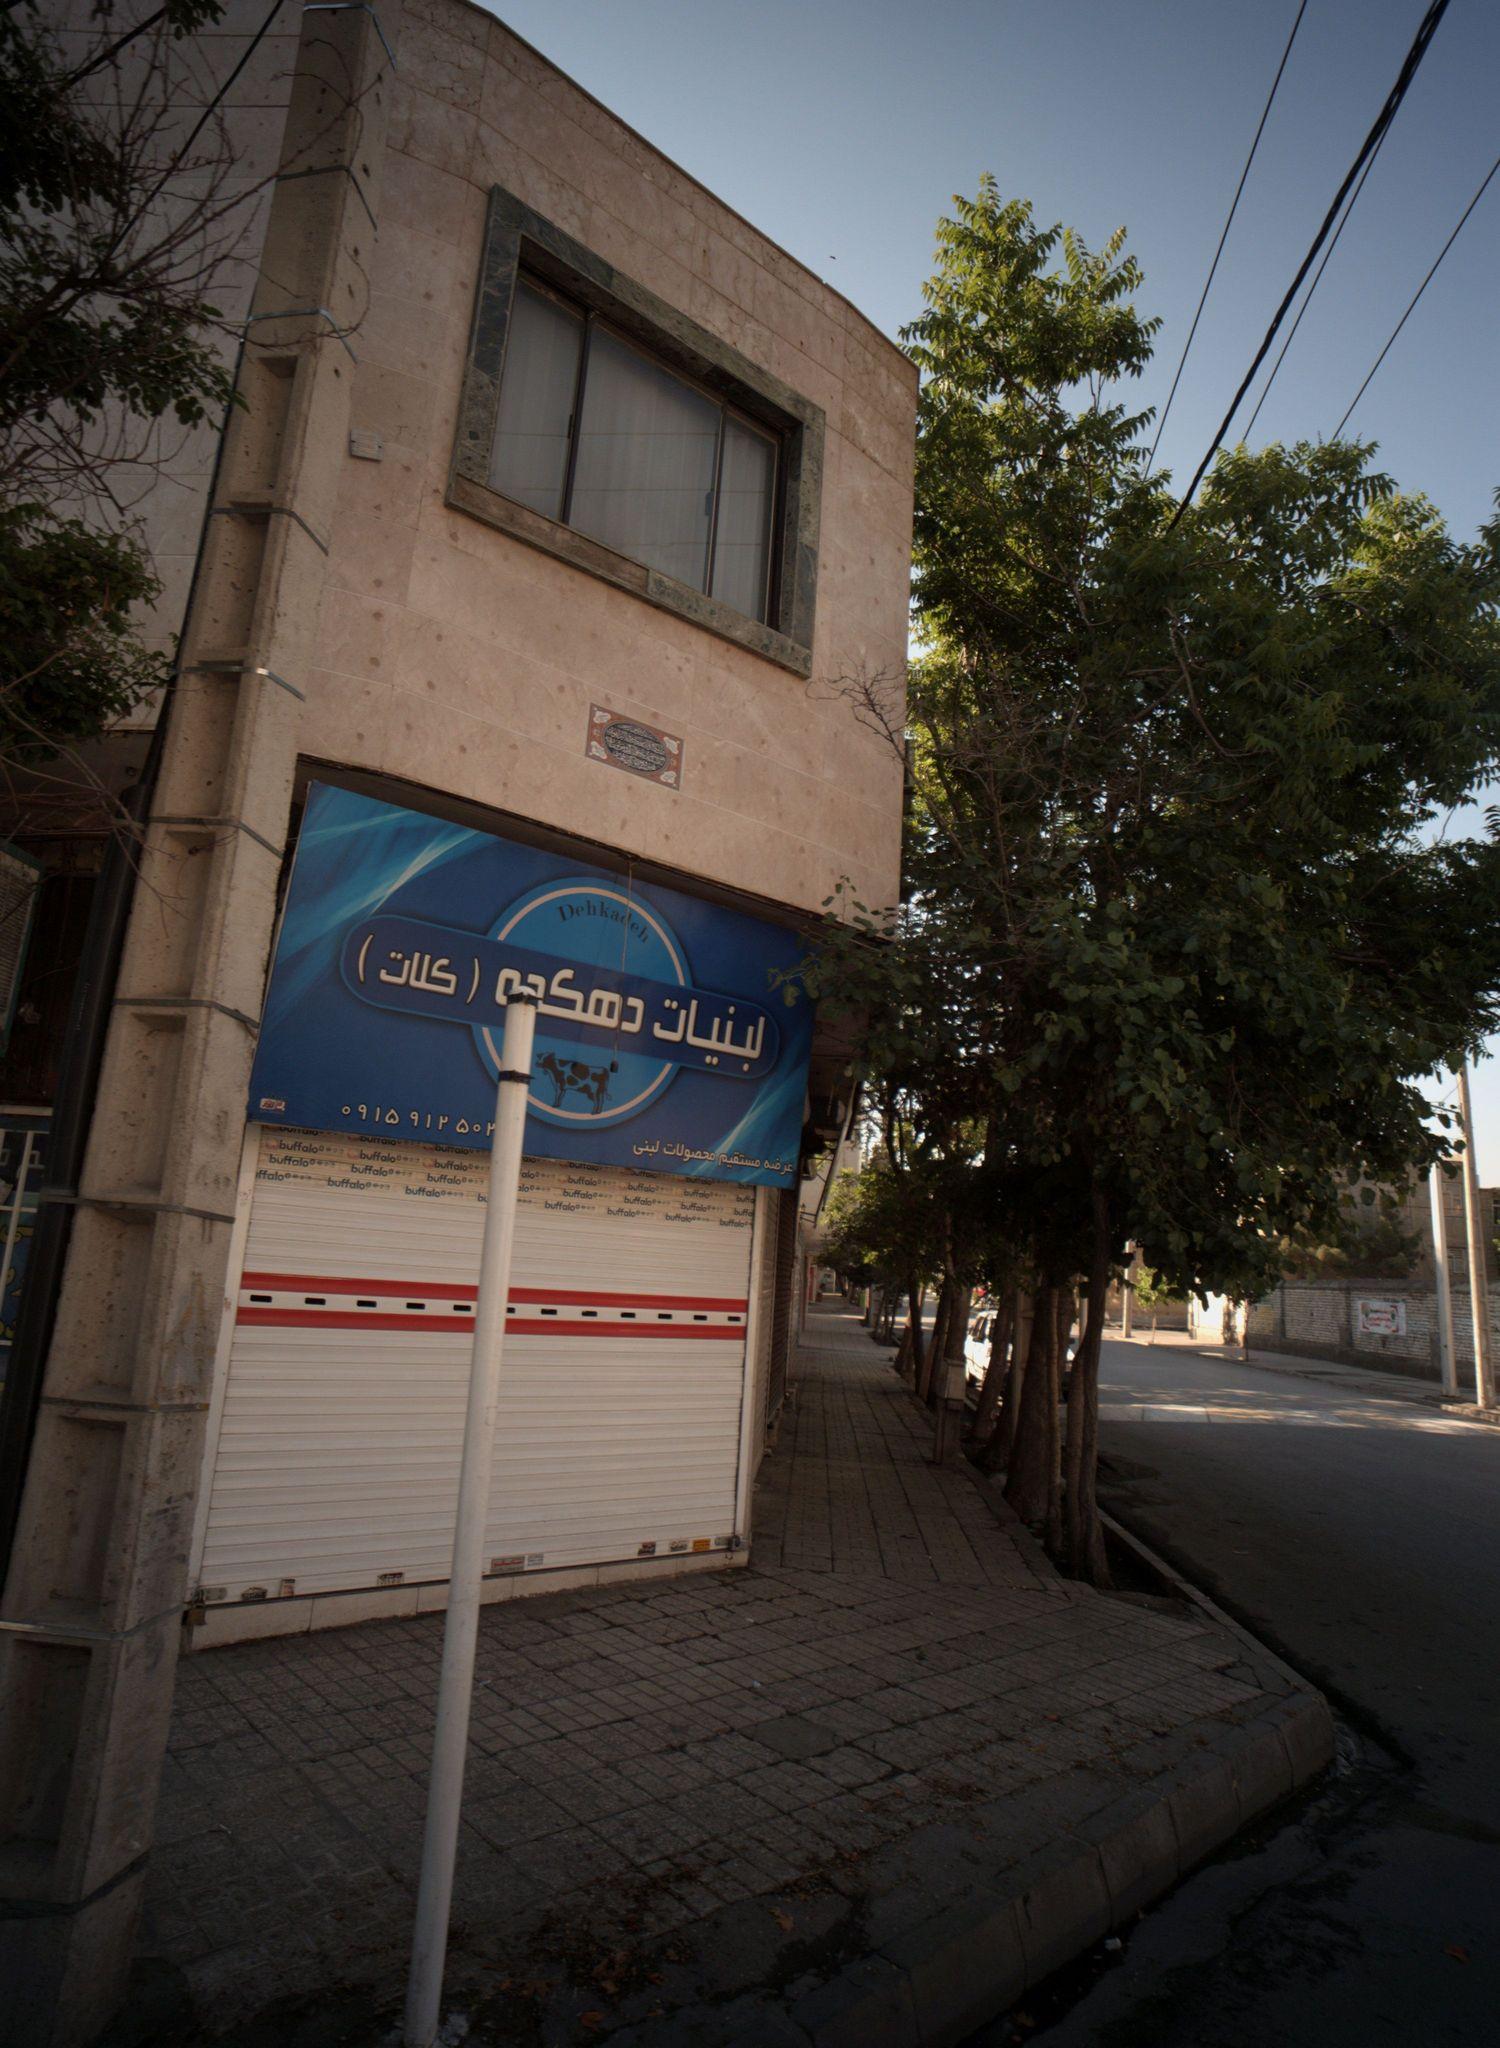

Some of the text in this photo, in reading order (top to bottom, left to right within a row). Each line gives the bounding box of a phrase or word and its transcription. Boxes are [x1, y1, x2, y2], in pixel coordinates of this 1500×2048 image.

[557, 899, 650, 944] Dehkadeh
[494, 966, 646, 1034] دهکده
[652, 997, 766, 1073] لبنیات
[341, 1103, 497, 1137] ۰۹۱۵ ۹۱۲ ۵۰۲
[268, 1153, 309, 1168] buffalo
[350, 1163, 388, 1178] buffalo
[426, 1173, 462, 1186] buffalo
[562, 1189, 593, 1202] buffalo
[623, 1196, 653, 1207] buffalo
[680, 1202, 708, 1213] buffalo
[278, 1139, 319, 1154] buffalo
[359, 1149, 396, 1164] buffalo
[434, 1160, 468, 1172] buffalo
[567, 1175, 598, 1187] buffalo
[627, 1183, 656, 1194] buffalo
[683, 1190, 711, 1200] buffalo
[632, 1139, 793, 1175] عرضه مستقیم محصولات لبنی
[256, 1169, 745, 1228] ffalo buffalo buffalo buffalo buffalo buffalo buffalo
